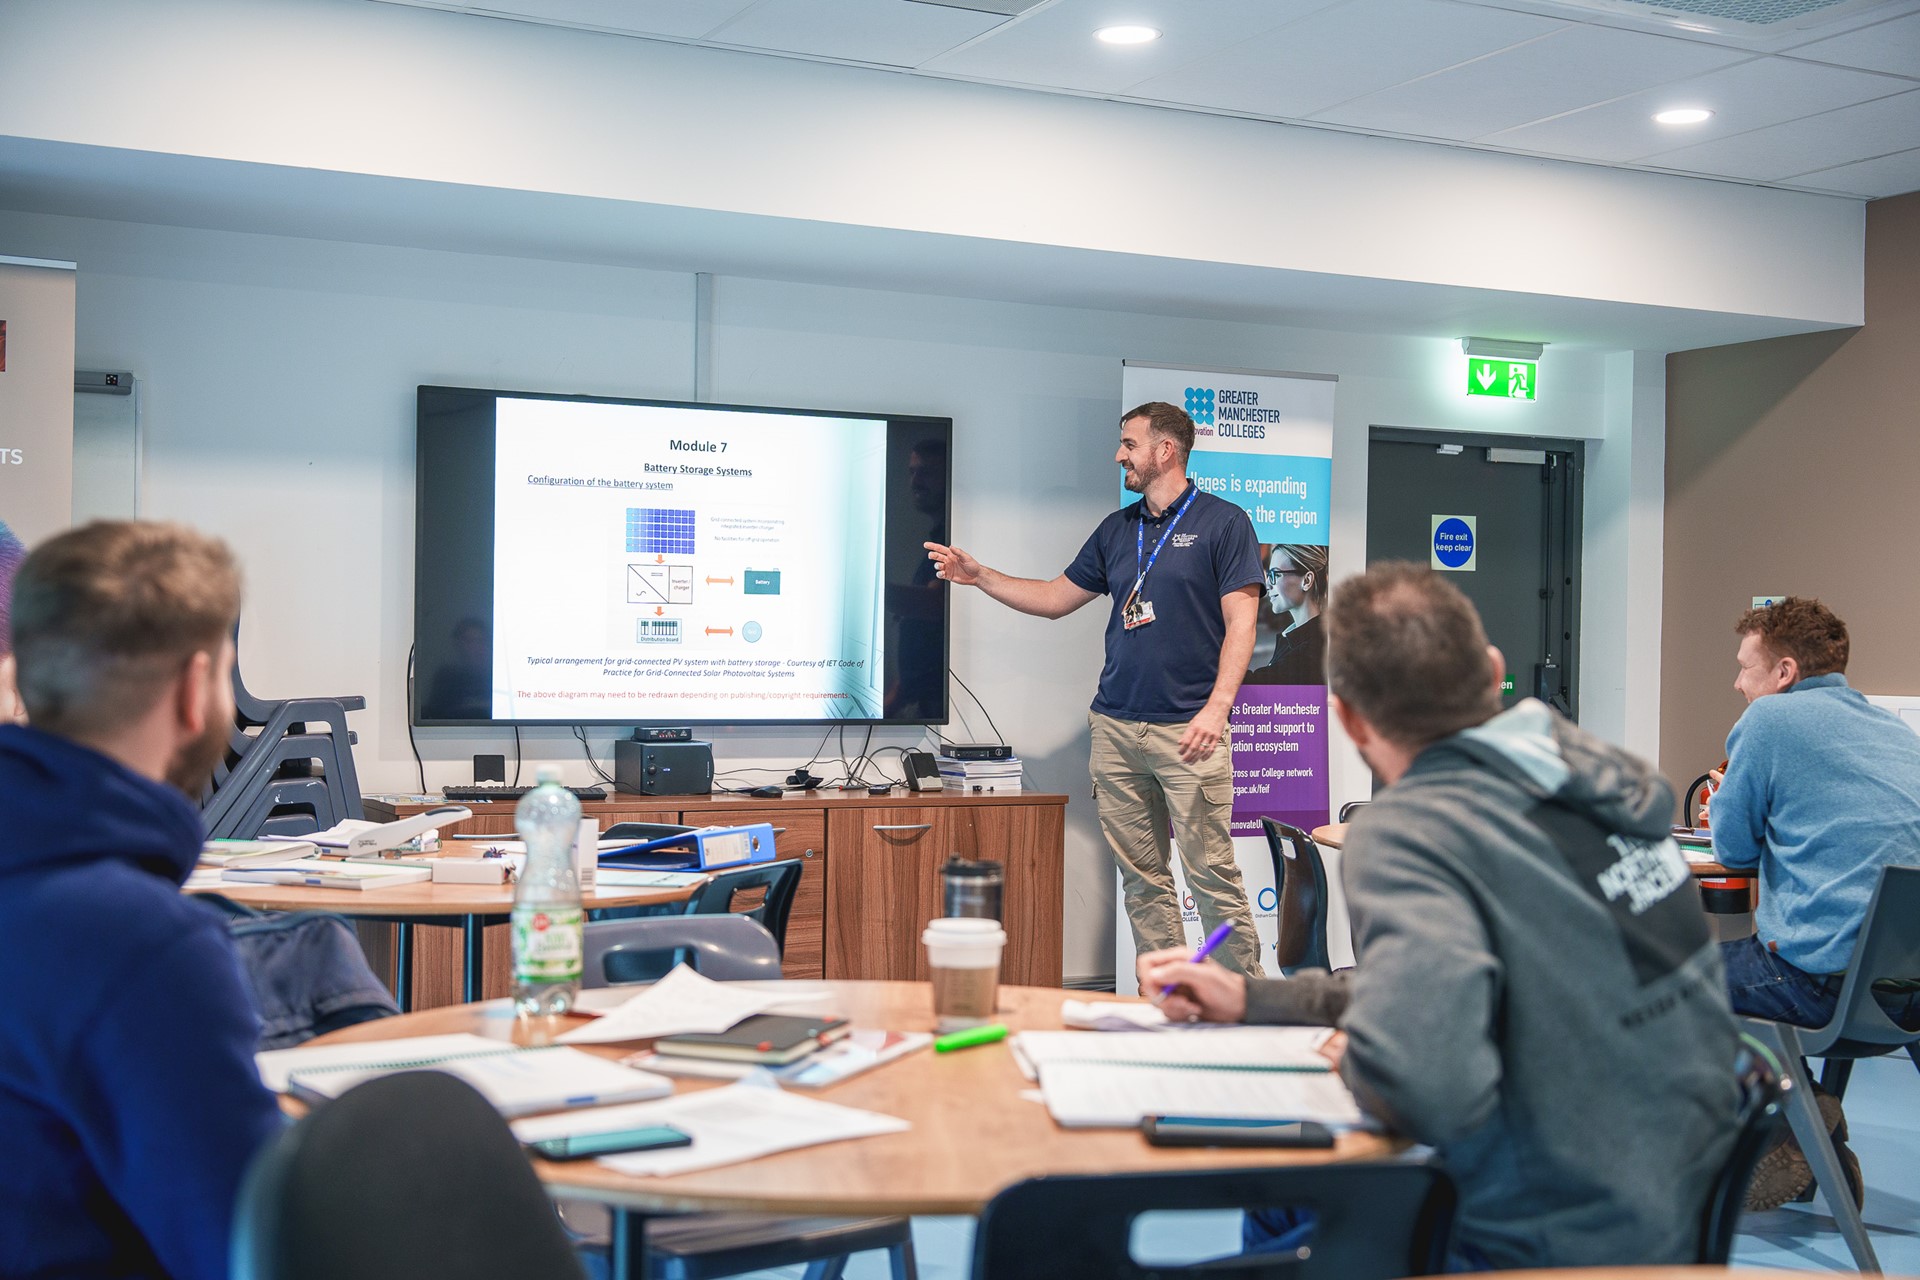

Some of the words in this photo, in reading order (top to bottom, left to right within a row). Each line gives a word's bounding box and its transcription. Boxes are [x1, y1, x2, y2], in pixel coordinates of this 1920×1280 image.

[1219, 390, 1258, 405] GREATER
[1219, 406, 1280, 423] MANCHESTER
[1219, 423, 1265, 439] COLLEGES
[670, 440, 716, 452] Module
[720, 442, 727, 453] 7
[644, 463, 677, 475] Battery
[680, 464, 714, 476] Storage
[716, 466, 752, 477] Systems
[528, 475, 584, 486] Configuration
[587, 478, 595, 486] of
[598, 478, 611, 487] the
[614, 479, 643, 489] battery
[645, 481, 673, 490] system
[1231, 474, 1240, 492] is
[1245, 476, 1307, 500] expanding
[1256, 505, 1275, 523] the
[1280, 506, 1317, 528] region
[1436, 543, 1453, 552] keep
[527, 657, 553, 665] Typical
[554, 657, 603, 666] arrangement
[604, 657, 615, 666] for
[617, 657, 671, 666] grid-connected
[684, 659, 708, 667] system
[728, 659, 752, 667] battery
[787, 660, 816, 668] Courtesy
[818, 660, 825, 668] of
[856, 660, 864, 668] of
[633, 669, 644, 677] for
[558, 691, 587, 699] diagram
[680, 692, 718, 700] depending
[730, 692, 800, 700] publishing/copyright
[1242, 703, 1272, 715] Greater
[1274, 703, 1320, 715] Manchester
[1256, 722, 1271, 733] and
[1274, 722, 1305, 736] support
[1307, 722, 1314, 733] to
[1255, 741, 1298, 754] ecosystem
[1262, 768, 1285, 779] College
[1286, 768, 1313, 777] network
